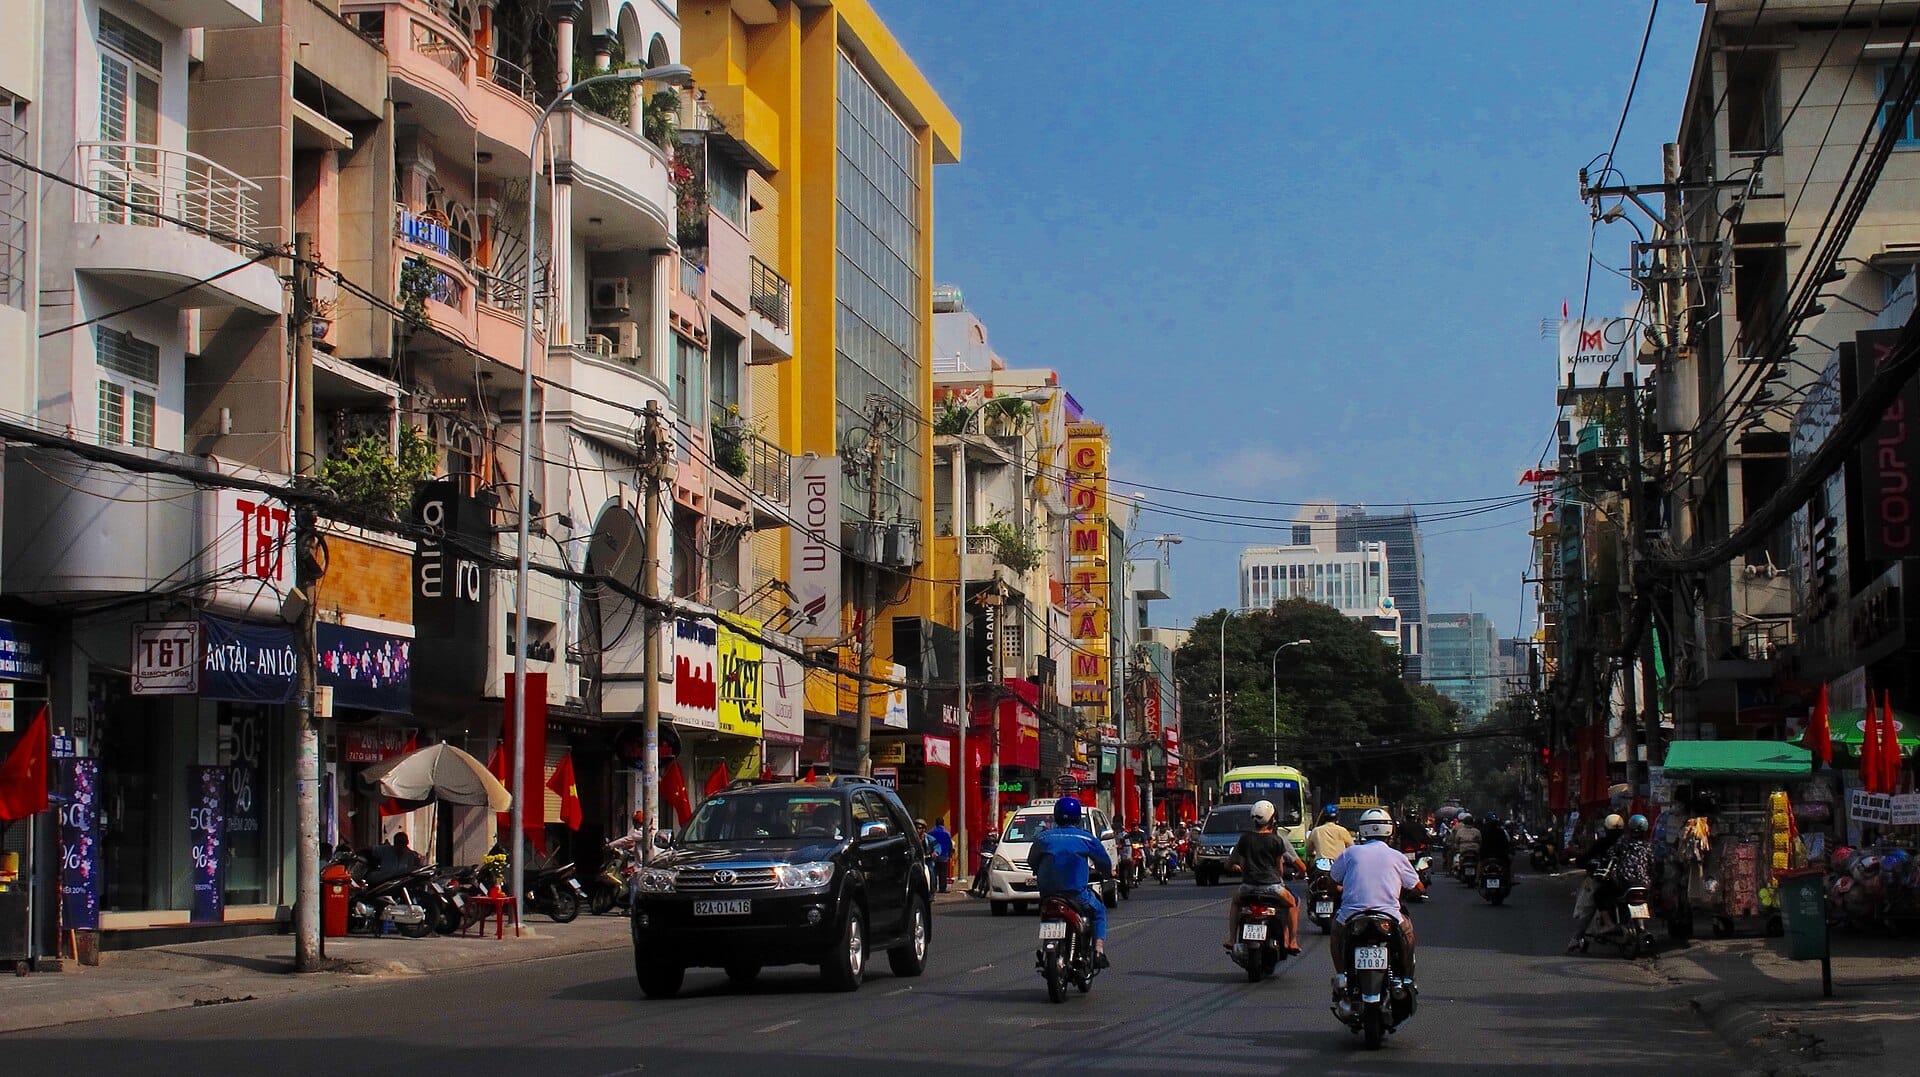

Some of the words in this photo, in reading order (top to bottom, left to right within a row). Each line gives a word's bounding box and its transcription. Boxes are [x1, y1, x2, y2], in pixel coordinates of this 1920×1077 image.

[1568, 354, 1619, 363] KHATOCO
[803, 475, 827, 571] wacoal
[237, 499, 294, 581] T&T
[141, 638, 191, 668] T&T
[205, 643, 225, 672] AN
[226, 640, 248, 673] TÀI
[257, 656, 277, 675] AN
[695, 901, 750, 913] 82A-014.16
[1359, 949, 1383, 959] 59-S2
